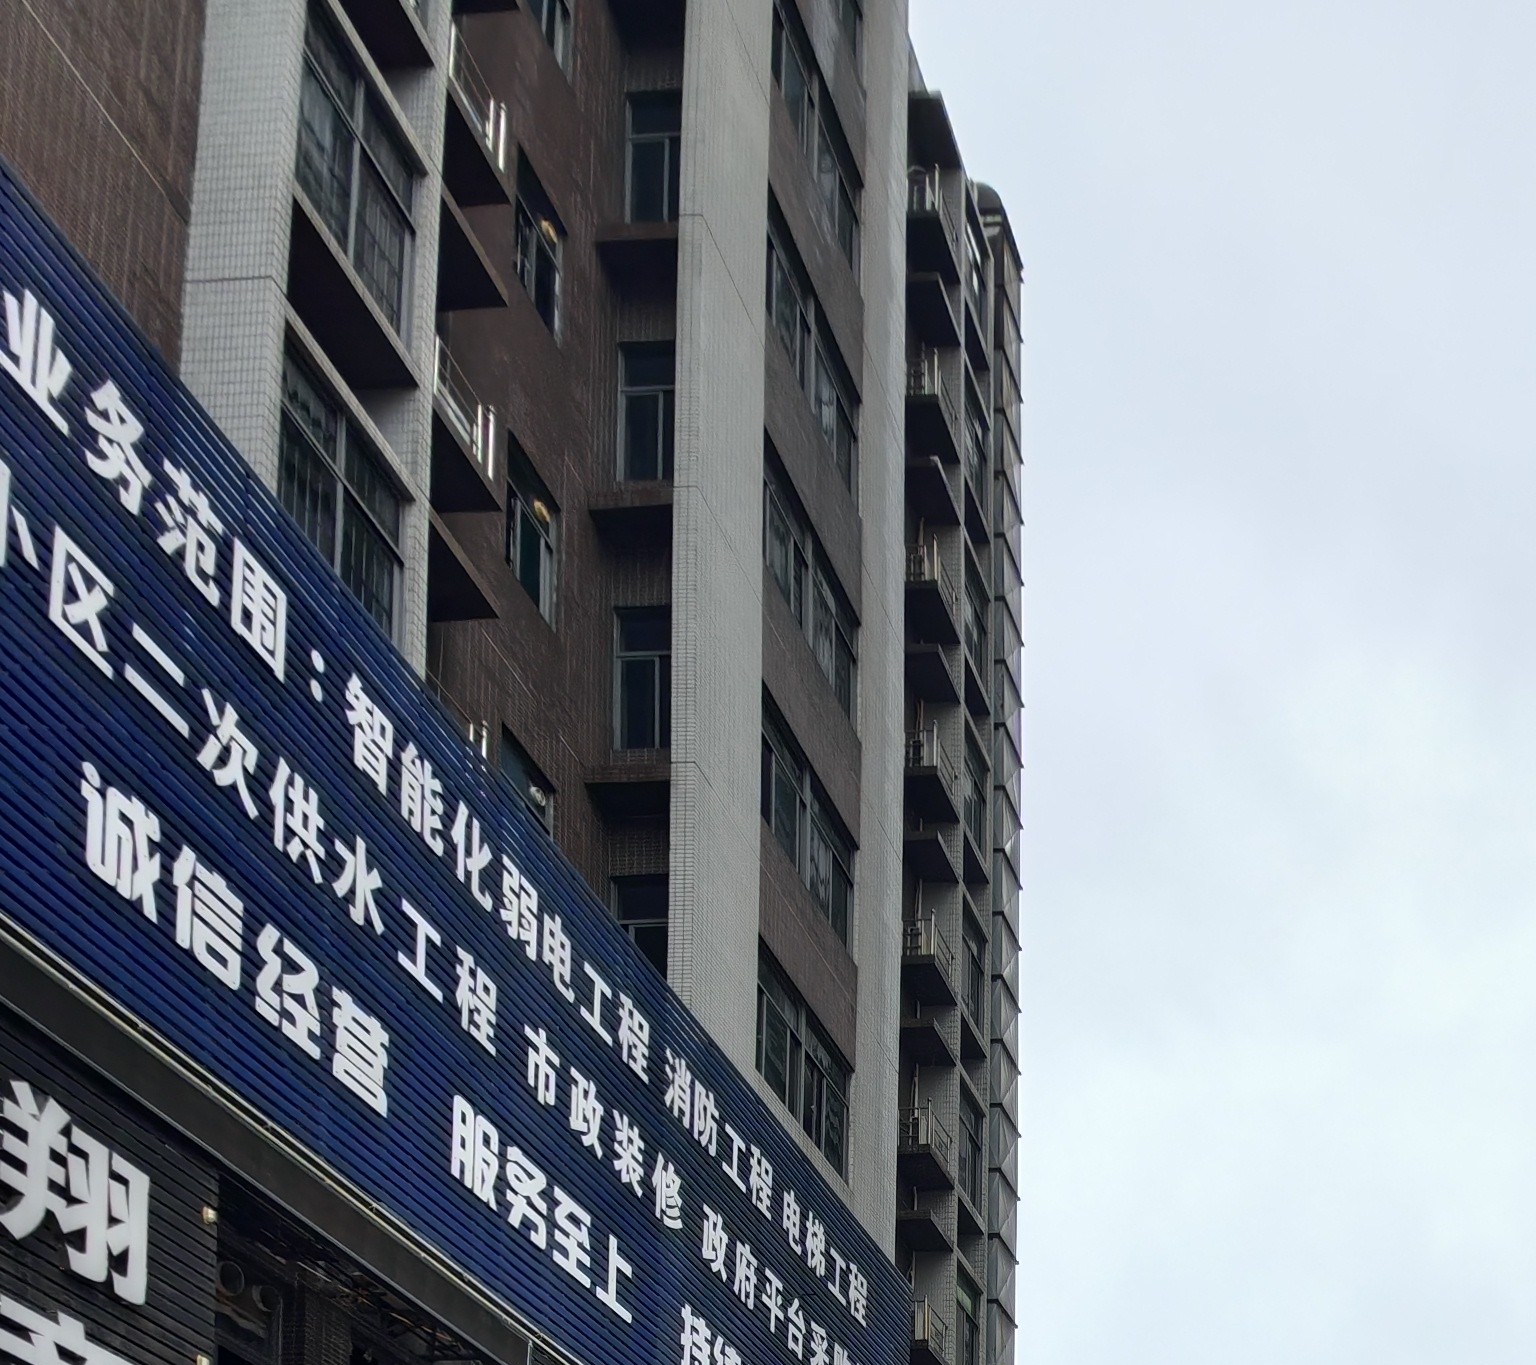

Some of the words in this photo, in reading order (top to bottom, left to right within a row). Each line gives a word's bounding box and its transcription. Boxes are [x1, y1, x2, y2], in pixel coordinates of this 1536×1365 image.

[81, 761, 389, 1118] 诚信经营
[449, 1094, 633, 1324] 服务至上
[524, 1024, 684, 1230] 市政装修
[663, 1047, 772, 1221] 消防工程
[782, 1189, 868, 1328] 电梯工程
